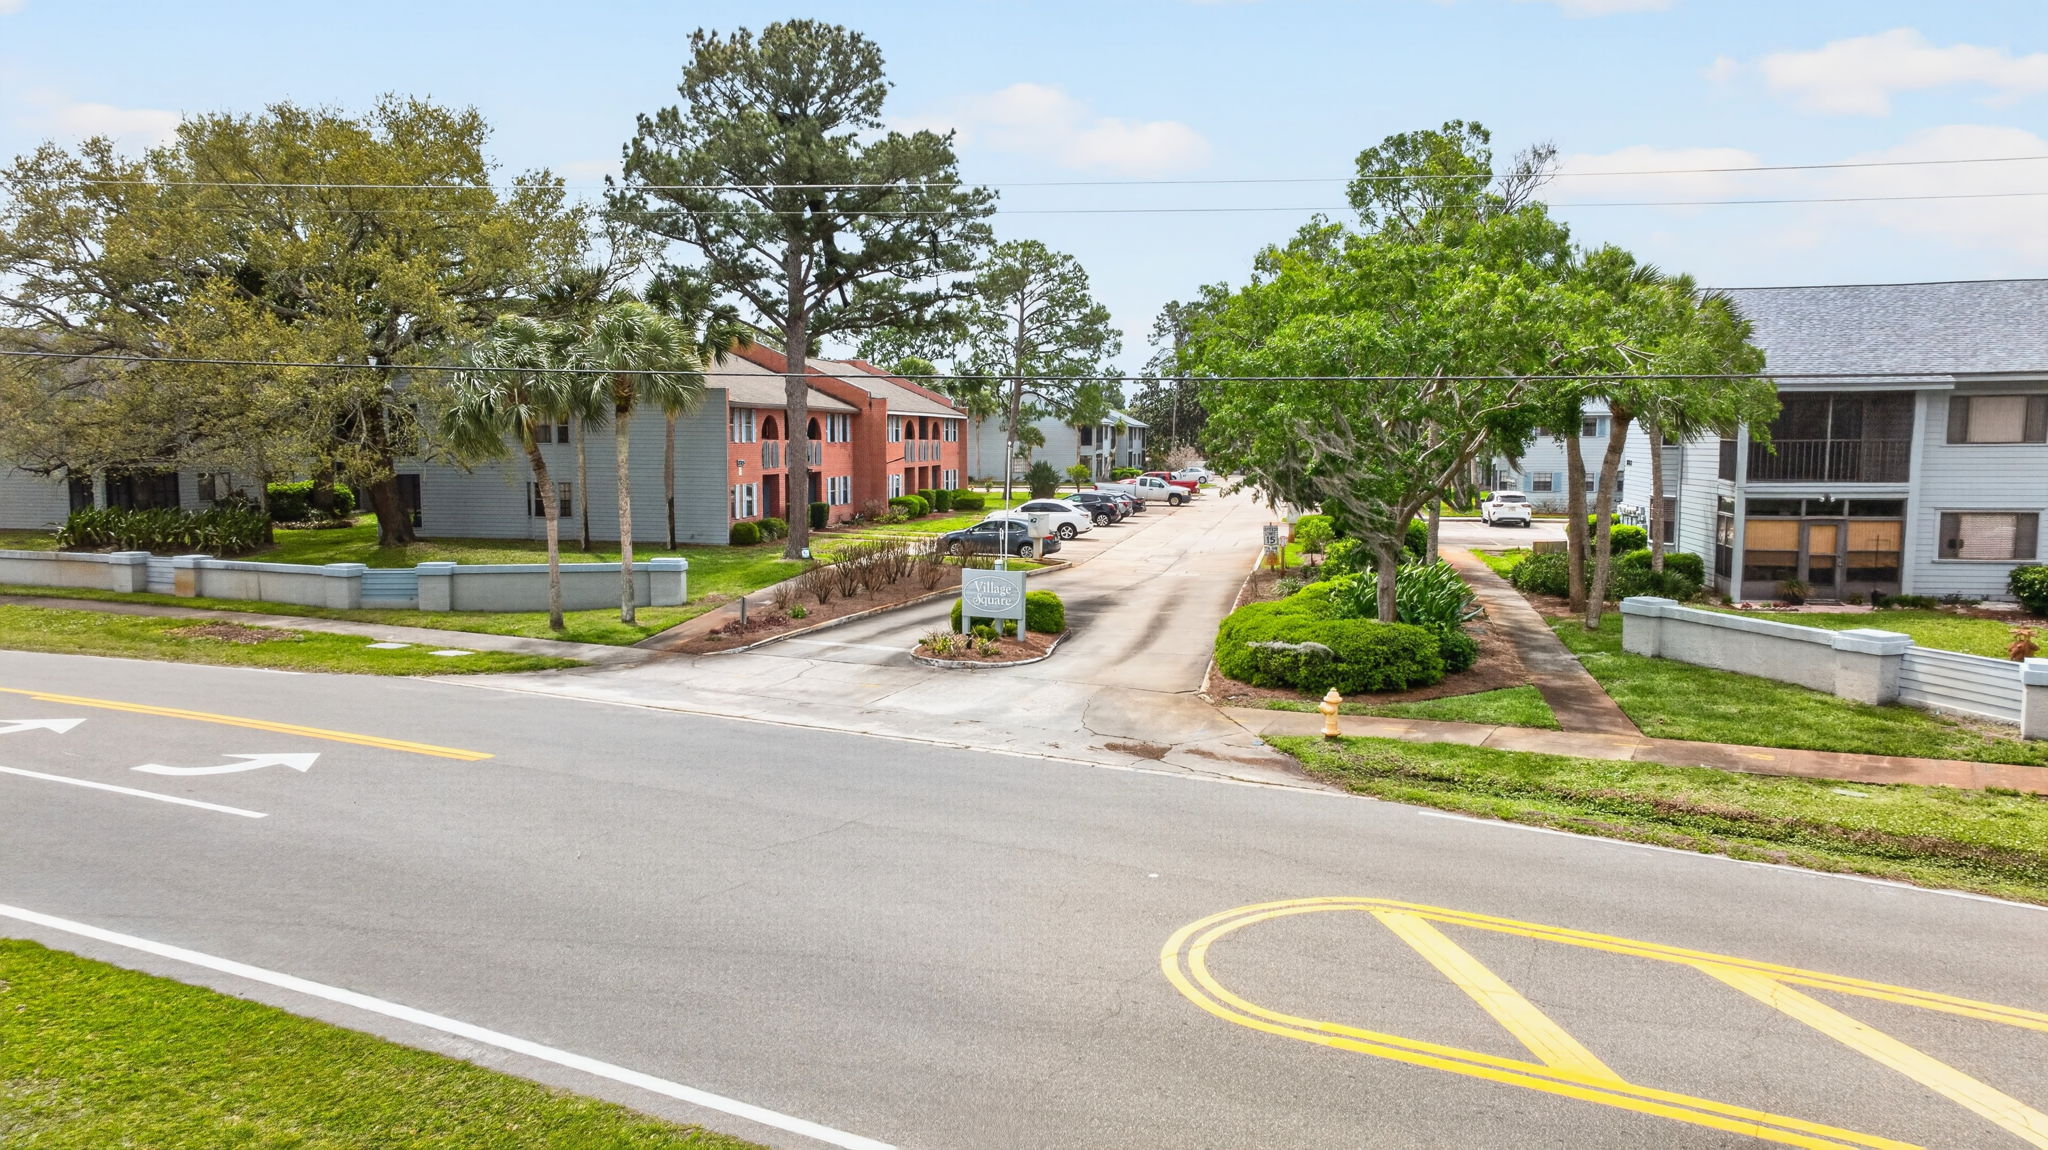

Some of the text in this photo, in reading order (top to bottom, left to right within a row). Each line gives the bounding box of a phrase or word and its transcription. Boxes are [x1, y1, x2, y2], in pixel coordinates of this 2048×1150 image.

[1266, 536, 1276, 544] 15
[974, 581, 1012, 596] Village
[973, 593, 1012, 606] Square
